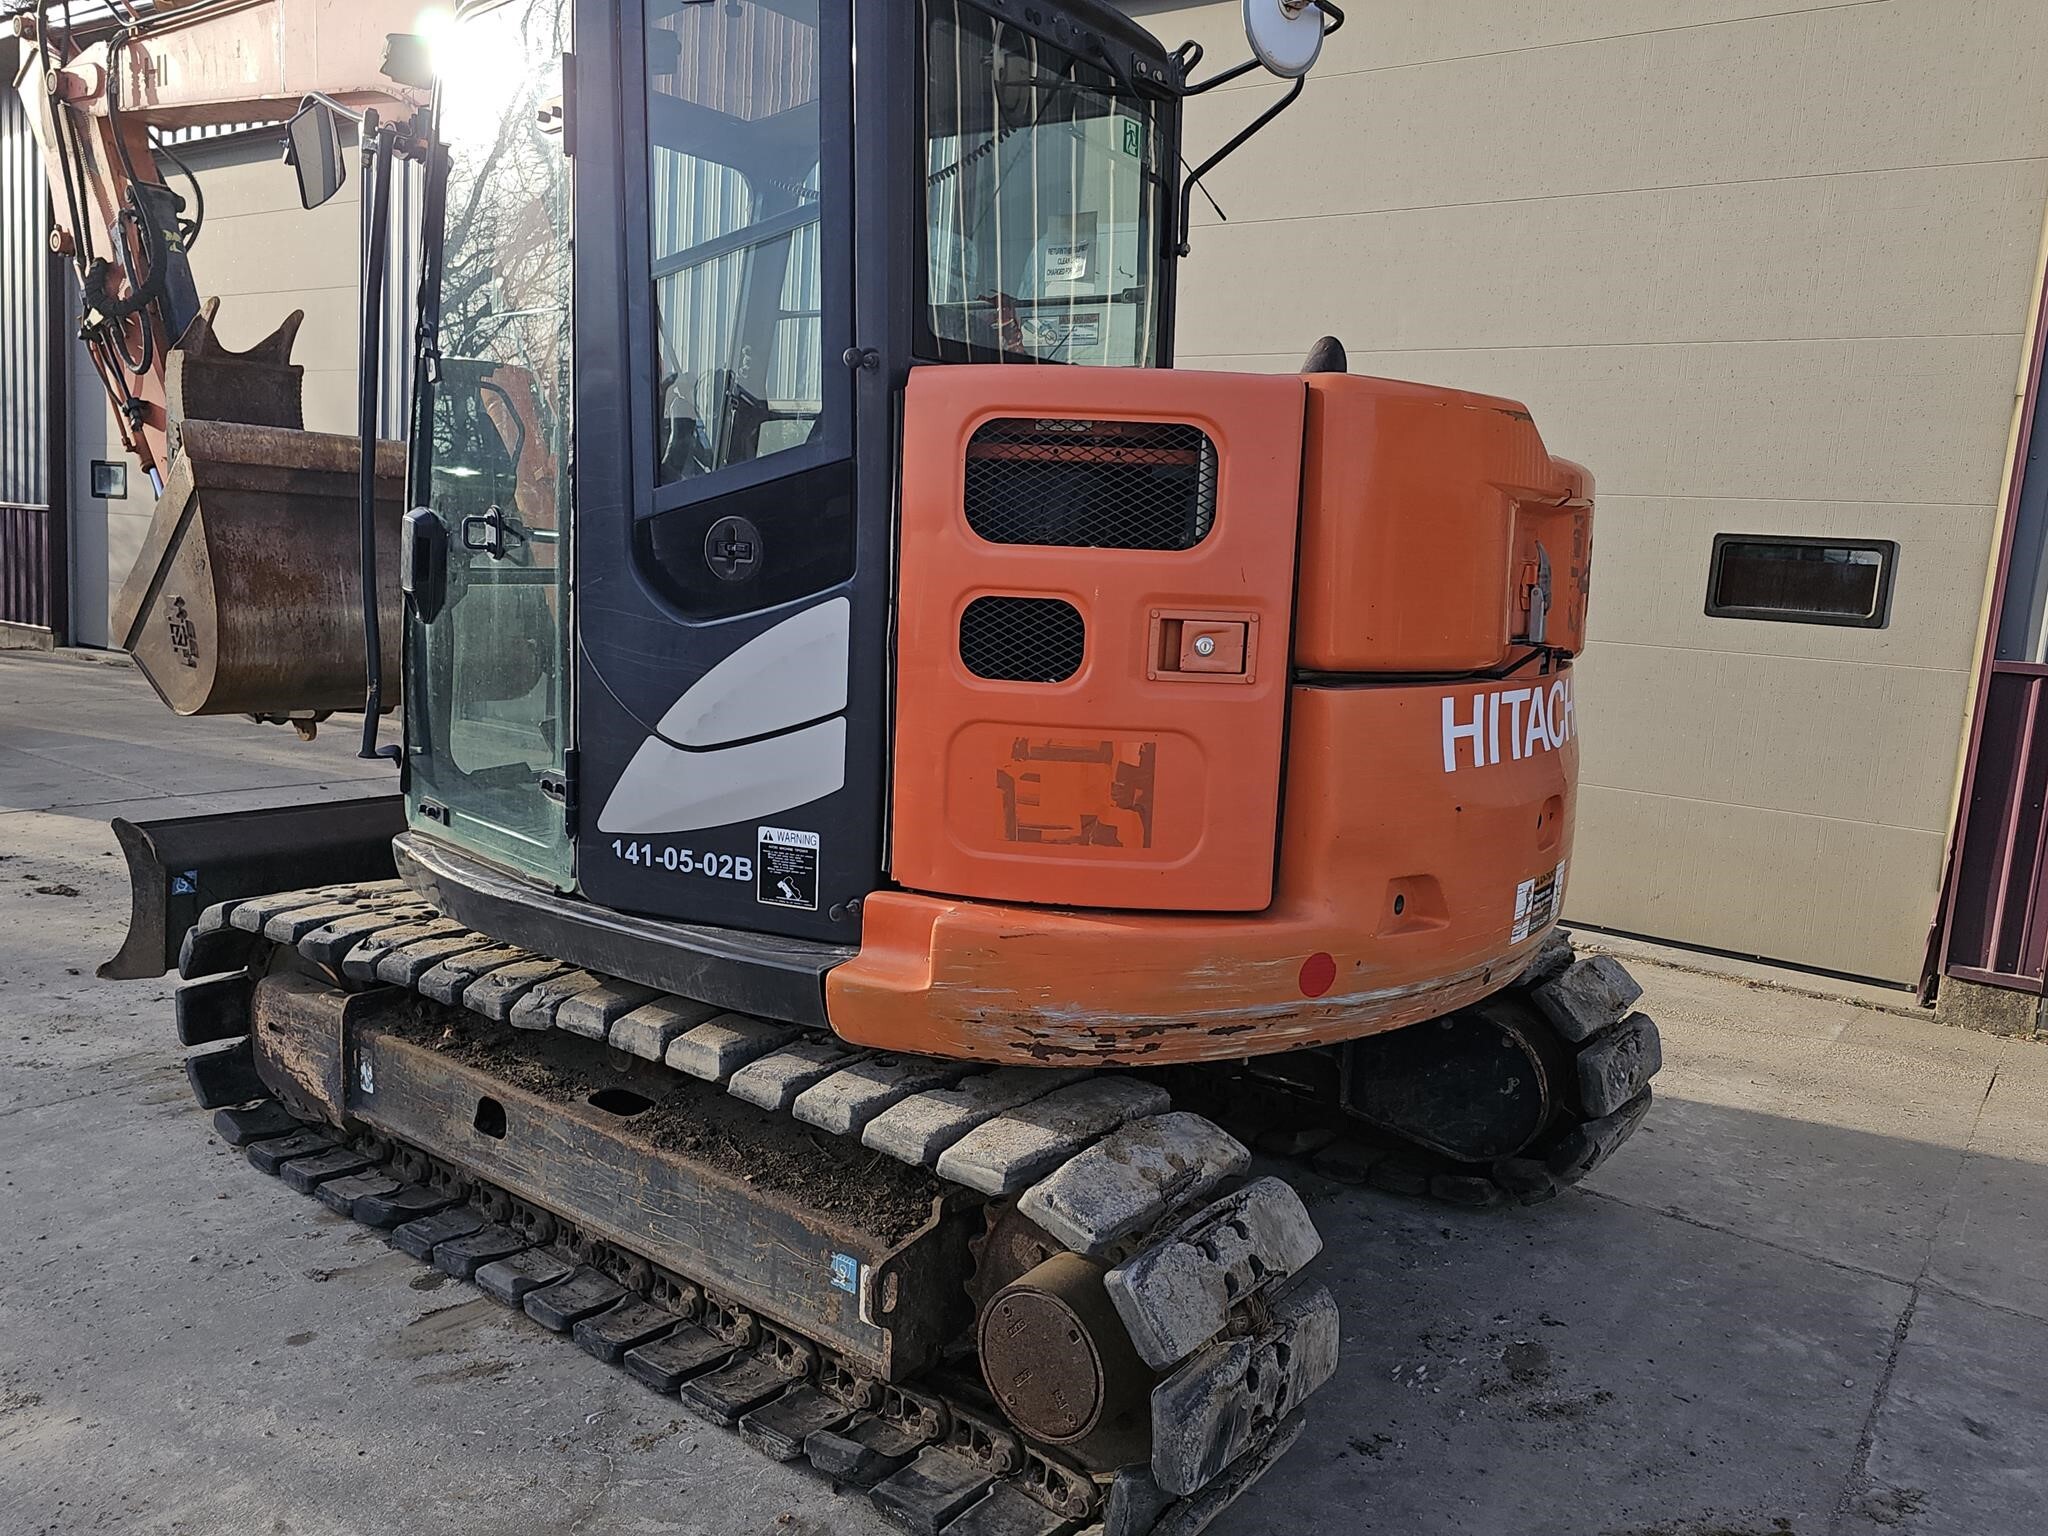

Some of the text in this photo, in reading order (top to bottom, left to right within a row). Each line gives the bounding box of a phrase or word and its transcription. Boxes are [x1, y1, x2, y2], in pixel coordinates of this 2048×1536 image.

[1442, 679, 1576, 773] HITACH
[777, 830, 817, 847] WARNING
[611, 839, 753, 882] 141-05-02B
